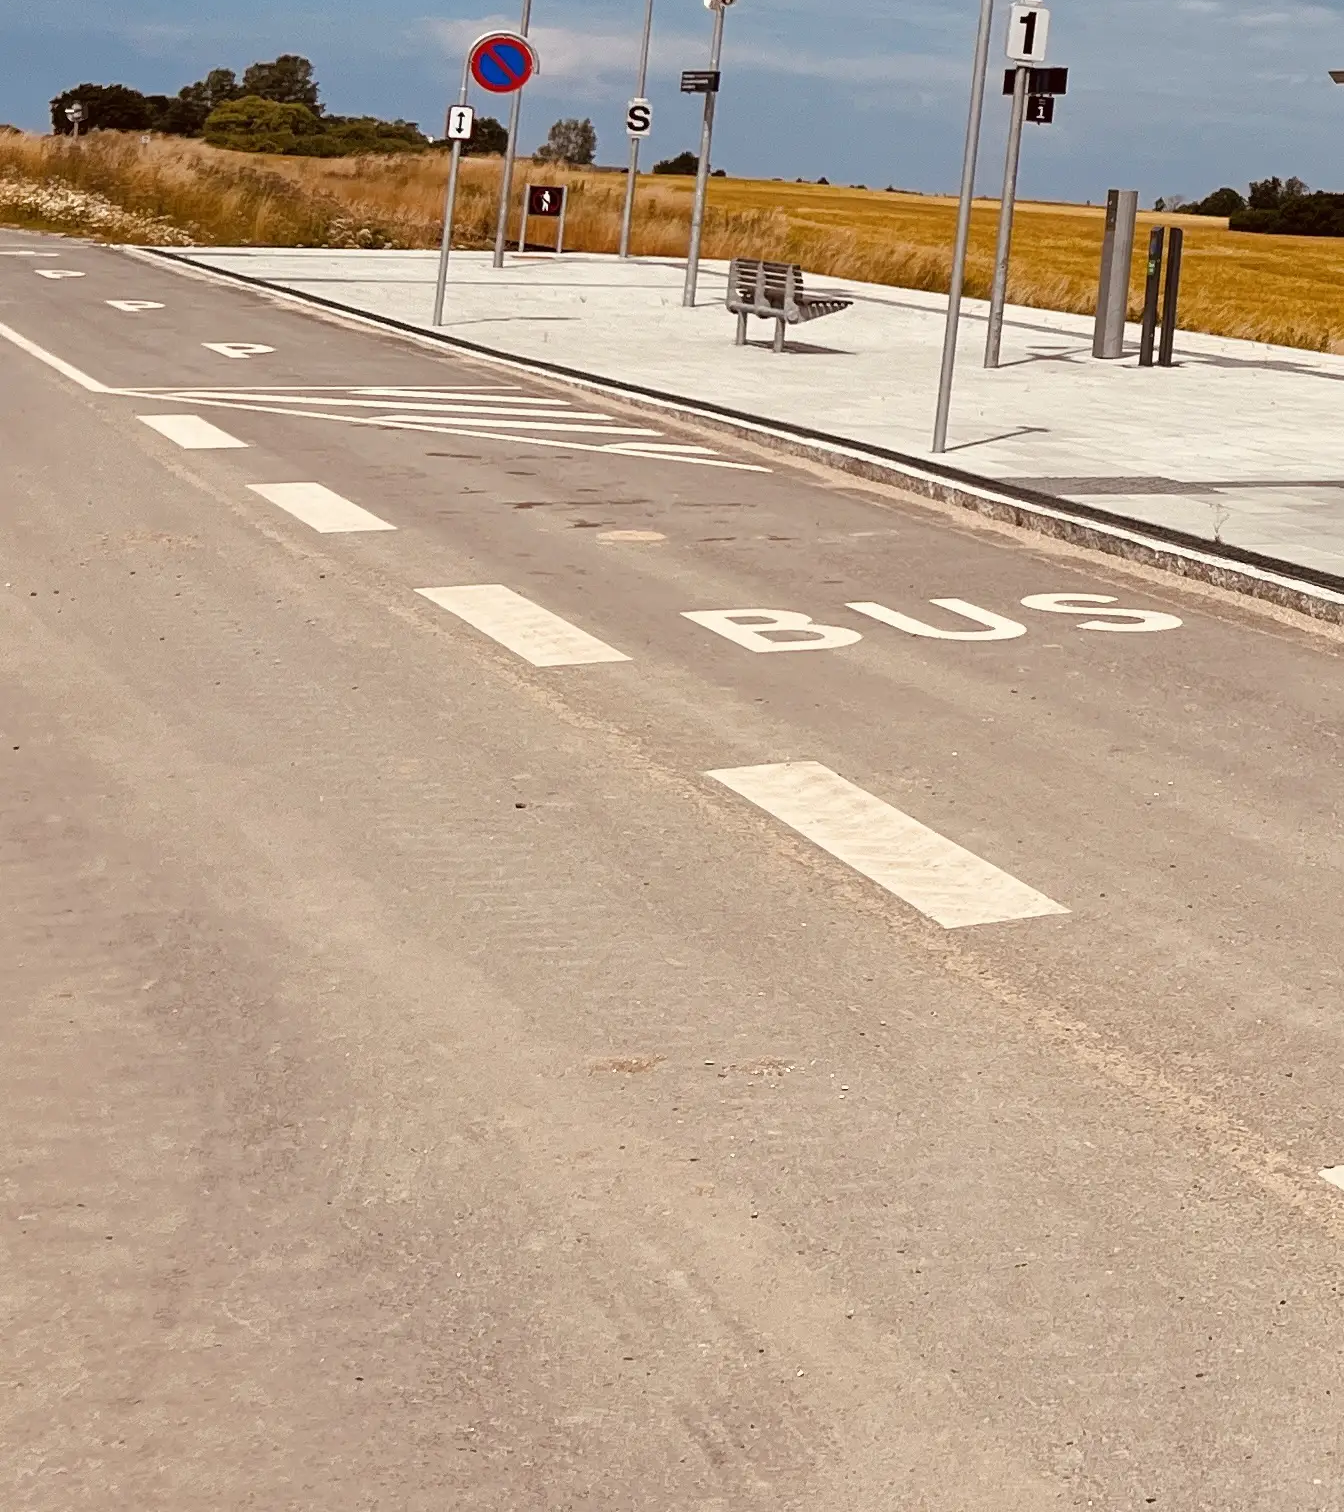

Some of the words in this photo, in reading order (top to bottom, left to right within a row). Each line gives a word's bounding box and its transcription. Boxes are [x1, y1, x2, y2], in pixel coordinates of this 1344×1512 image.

[1019, 11, 1037, 55] 1
[626, 105, 651, 131] S
[1035, 105, 1046, 119] 1
[679, 592, 1184, 654] BUS
